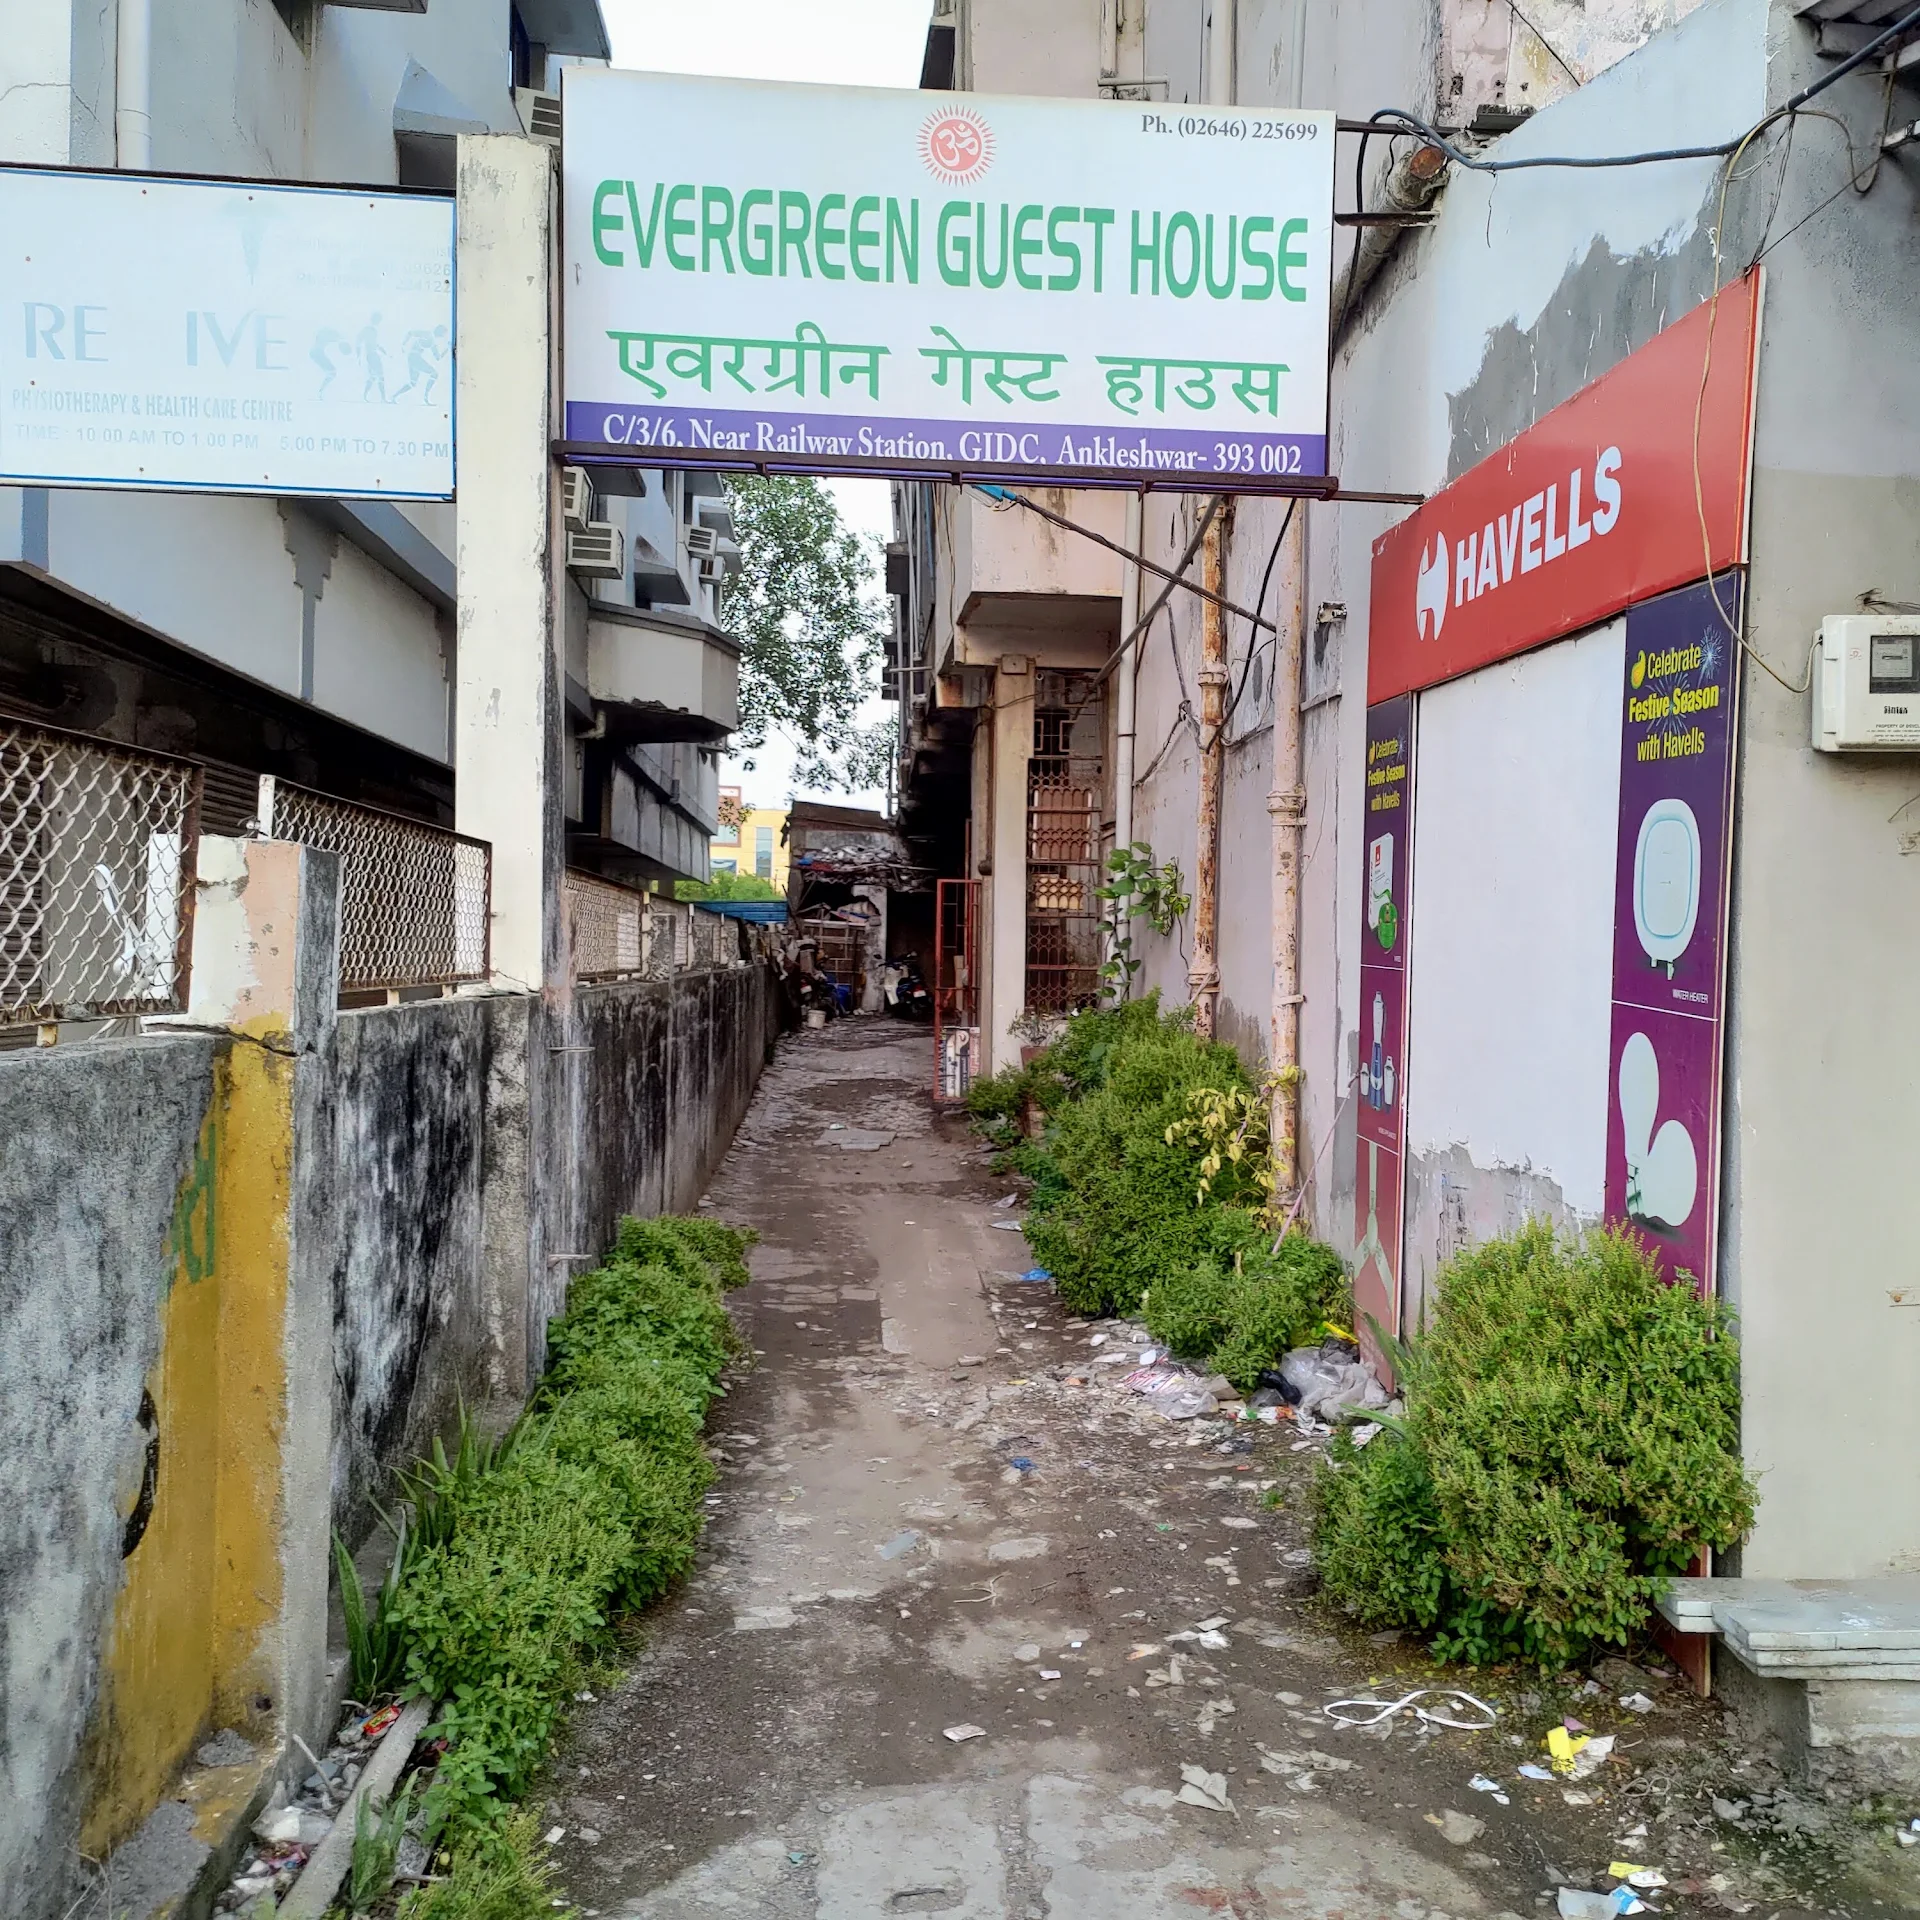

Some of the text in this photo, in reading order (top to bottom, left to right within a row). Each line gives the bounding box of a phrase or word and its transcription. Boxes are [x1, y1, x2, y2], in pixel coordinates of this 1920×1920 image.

[1142, 114, 1318, 141] Ph. (02646) 225699
[592, 179, 1308, 302] EVERGREEN GUEST HOUSE
[605, 321, 1291, 418] एवरग्रीन गेस्ट हाउस
[132, 395, 141, 415] &
[146, 395, 199, 418] HEALTH
[203, 398, 238, 420] CARE
[242, 399, 293, 422] CENTRE
[129, 429, 156, 445] AM
[162, 431, 185, 446] TO
[232, 433, 259, 450] PM
[321, 437, 347, 454] PM
[352, 438, 376, 455] TO
[382, 440, 417, 457] 7.30
[422, 442, 449, 458] PM
[689, 418, 751, 450] Near
[755, 421, 854, 456] Railway
[1213, 442, 1255, 472] 393
[1260, 444, 1302, 474] 002
[1455, 446, 1622, 608] HAVELLS
[1647, 642, 1701, 679] Celebrate
[1629, 685, 1719, 723] Festive Season
[1637, 727, 1705, 761] with Havells
